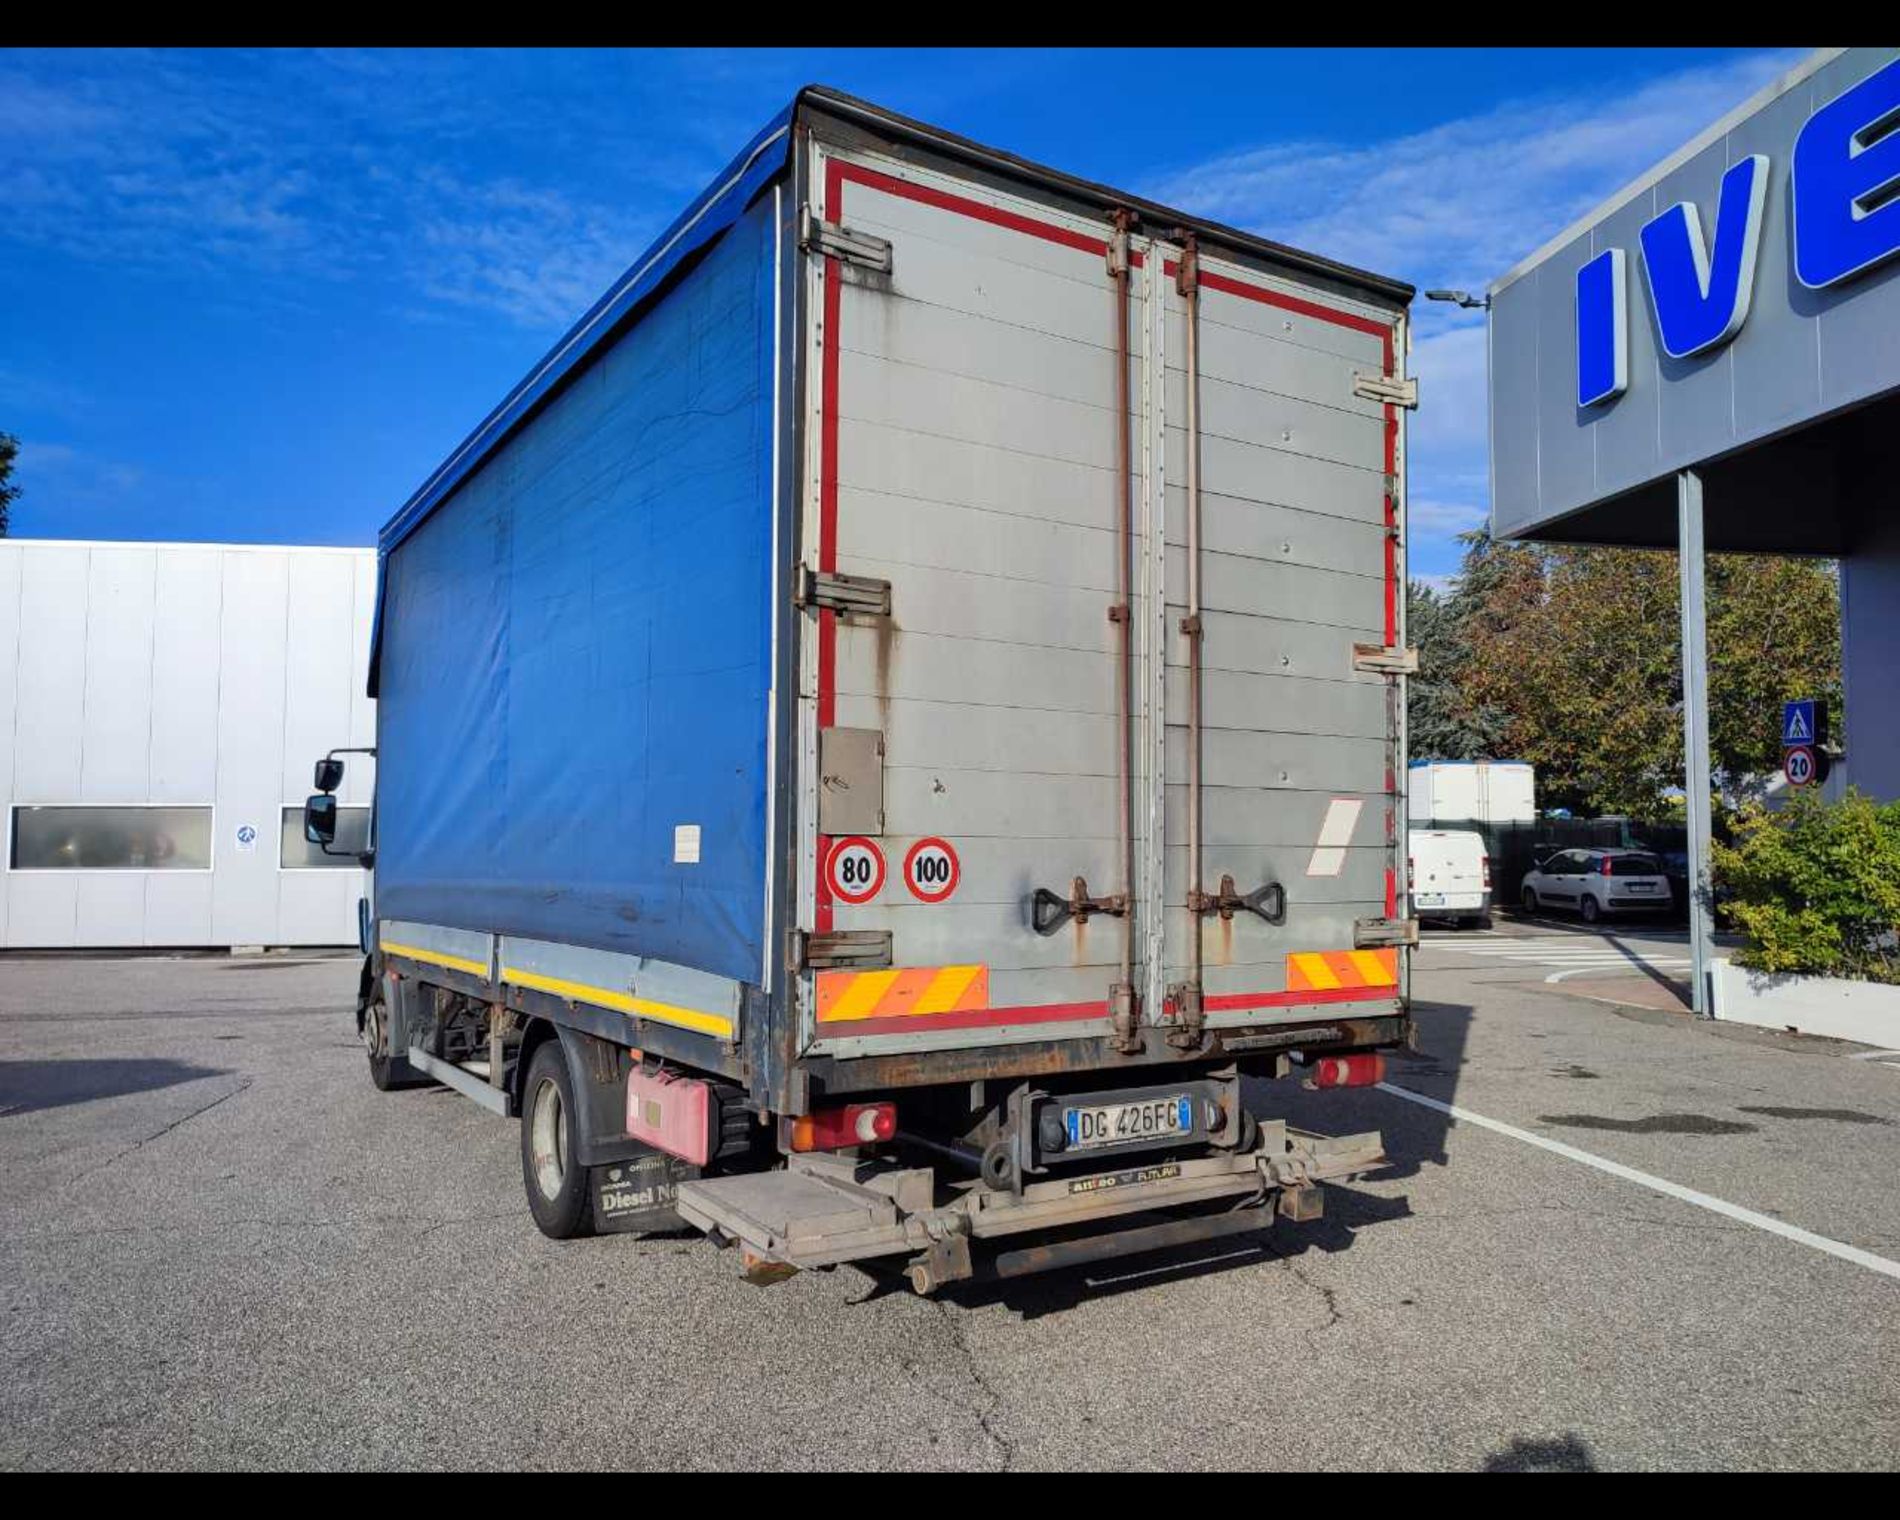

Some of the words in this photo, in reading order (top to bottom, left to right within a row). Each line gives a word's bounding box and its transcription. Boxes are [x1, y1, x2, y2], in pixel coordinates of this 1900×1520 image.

[1791, 758, 1808, 776] 20
[842, 856, 870, 883] 80
[916, 856, 949, 882] 100
[1081, 1111, 1107, 1139] DG
[1117, 1102, 1177, 1134] 426FG
[602, 1187, 654, 1211] Diesel
